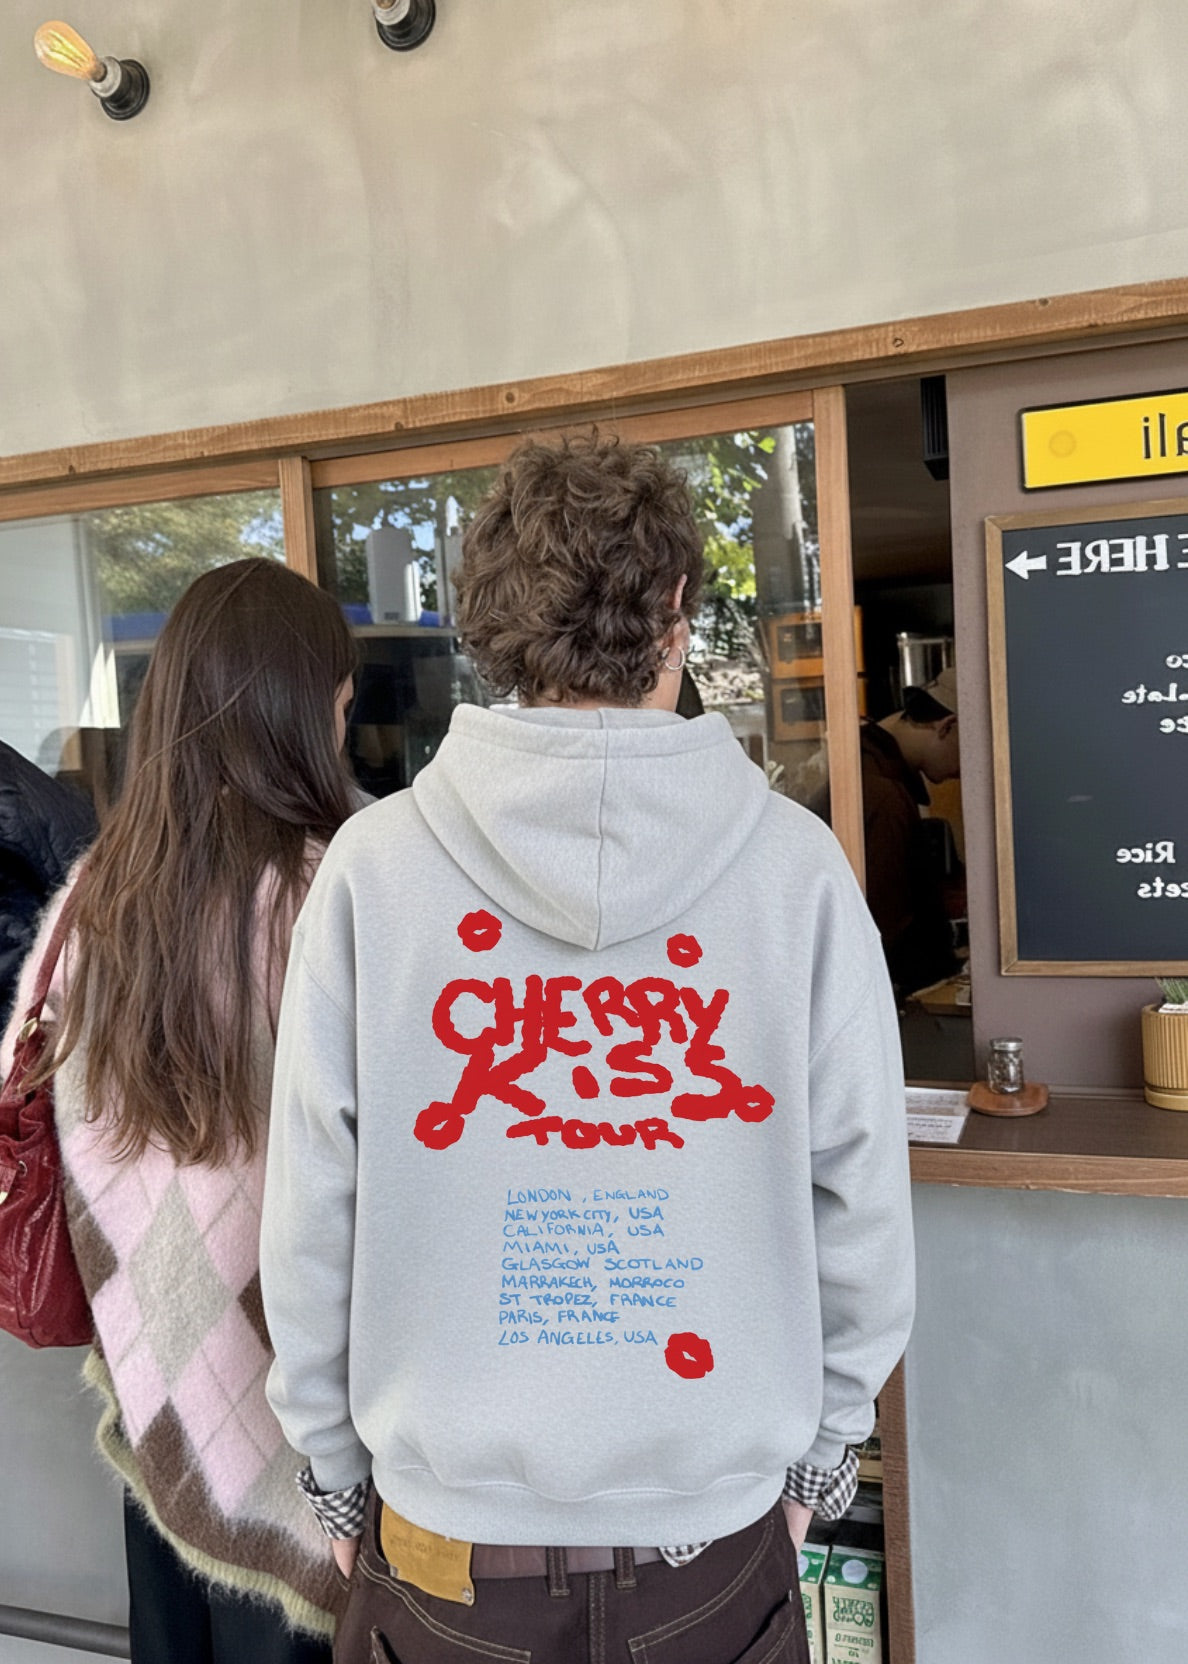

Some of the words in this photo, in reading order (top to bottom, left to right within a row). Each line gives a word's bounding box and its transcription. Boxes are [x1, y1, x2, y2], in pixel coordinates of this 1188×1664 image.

[432, 974, 730, 1056] CHERRY
[506, 1116, 684, 1150] TOUR
[506, 1188, 572, 1205] LONDON
[593, 1188, 670, 1201] ENGLAND
[628, 1205, 665, 1221] USA
[502, 1222, 615, 1239] CALIFORNIA,
[626, 1223, 665, 1237] USA
[502, 1240, 579, 1256] MIAMI,
[586, 1239, 621, 1255] USA
[500, 1256, 590, 1271] GLASGOW
[603, 1256, 705, 1271] SCOTLAND
[500, 1274, 598, 1293] MARRAKECH,
[608, 1276, 685, 1289] MORROCO
[498, 1292, 522, 1306] ST
[528, 1291, 599, 1309] TROPEZ,
[608, 1293, 678, 1308] FRANCE
[498, 1309, 550, 1326] PARIS,
[557, 1309, 621, 1324] FRANCE
[497, 1330, 531, 1346] LOS
[536, 1328, 618, 1347] ANGELES,
[623, 1330, 659, 1346] USA
